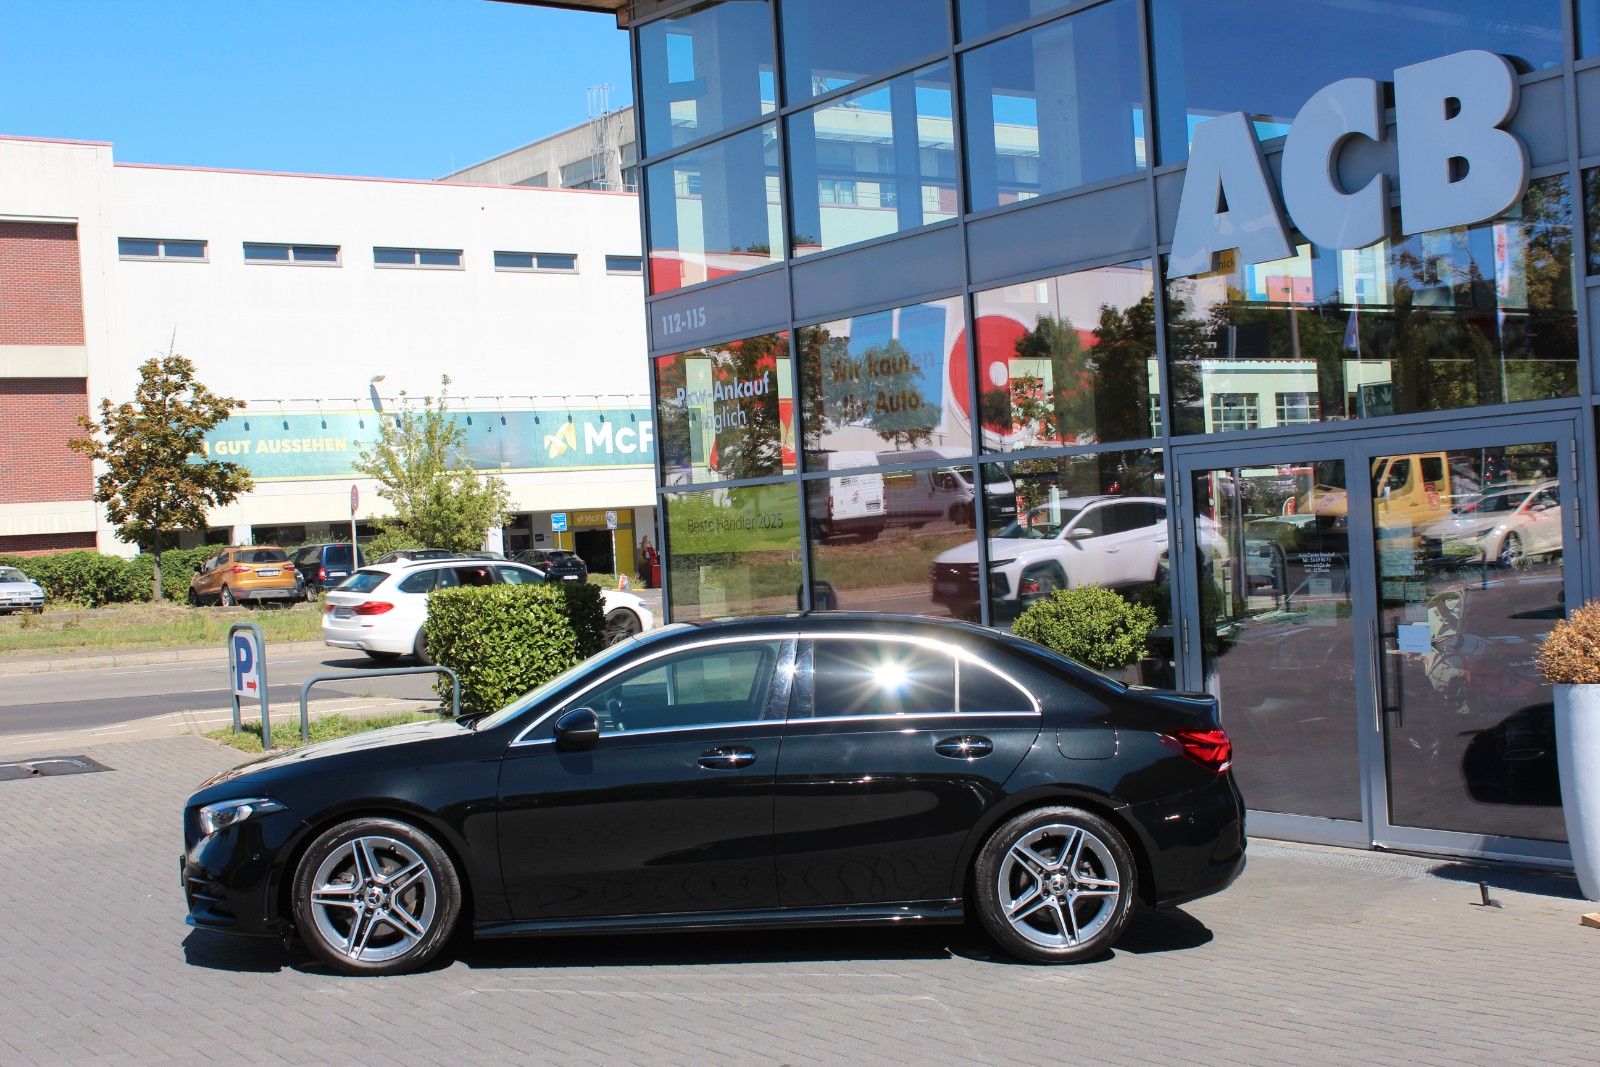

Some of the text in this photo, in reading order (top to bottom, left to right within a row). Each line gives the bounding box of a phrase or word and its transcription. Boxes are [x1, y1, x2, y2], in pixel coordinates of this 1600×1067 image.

[1166, 49, 1532, 279] ACB
[662, 306, 706, 336] 112-115
[676, 370, 770, 408] Pkw-Ankauf
[215, 440, 251, 456] GUT
[256, 437, 348, 454] AUSSEHEN
[758, 513, 784, 529] 2025
[234, 635, 254, 691] P
